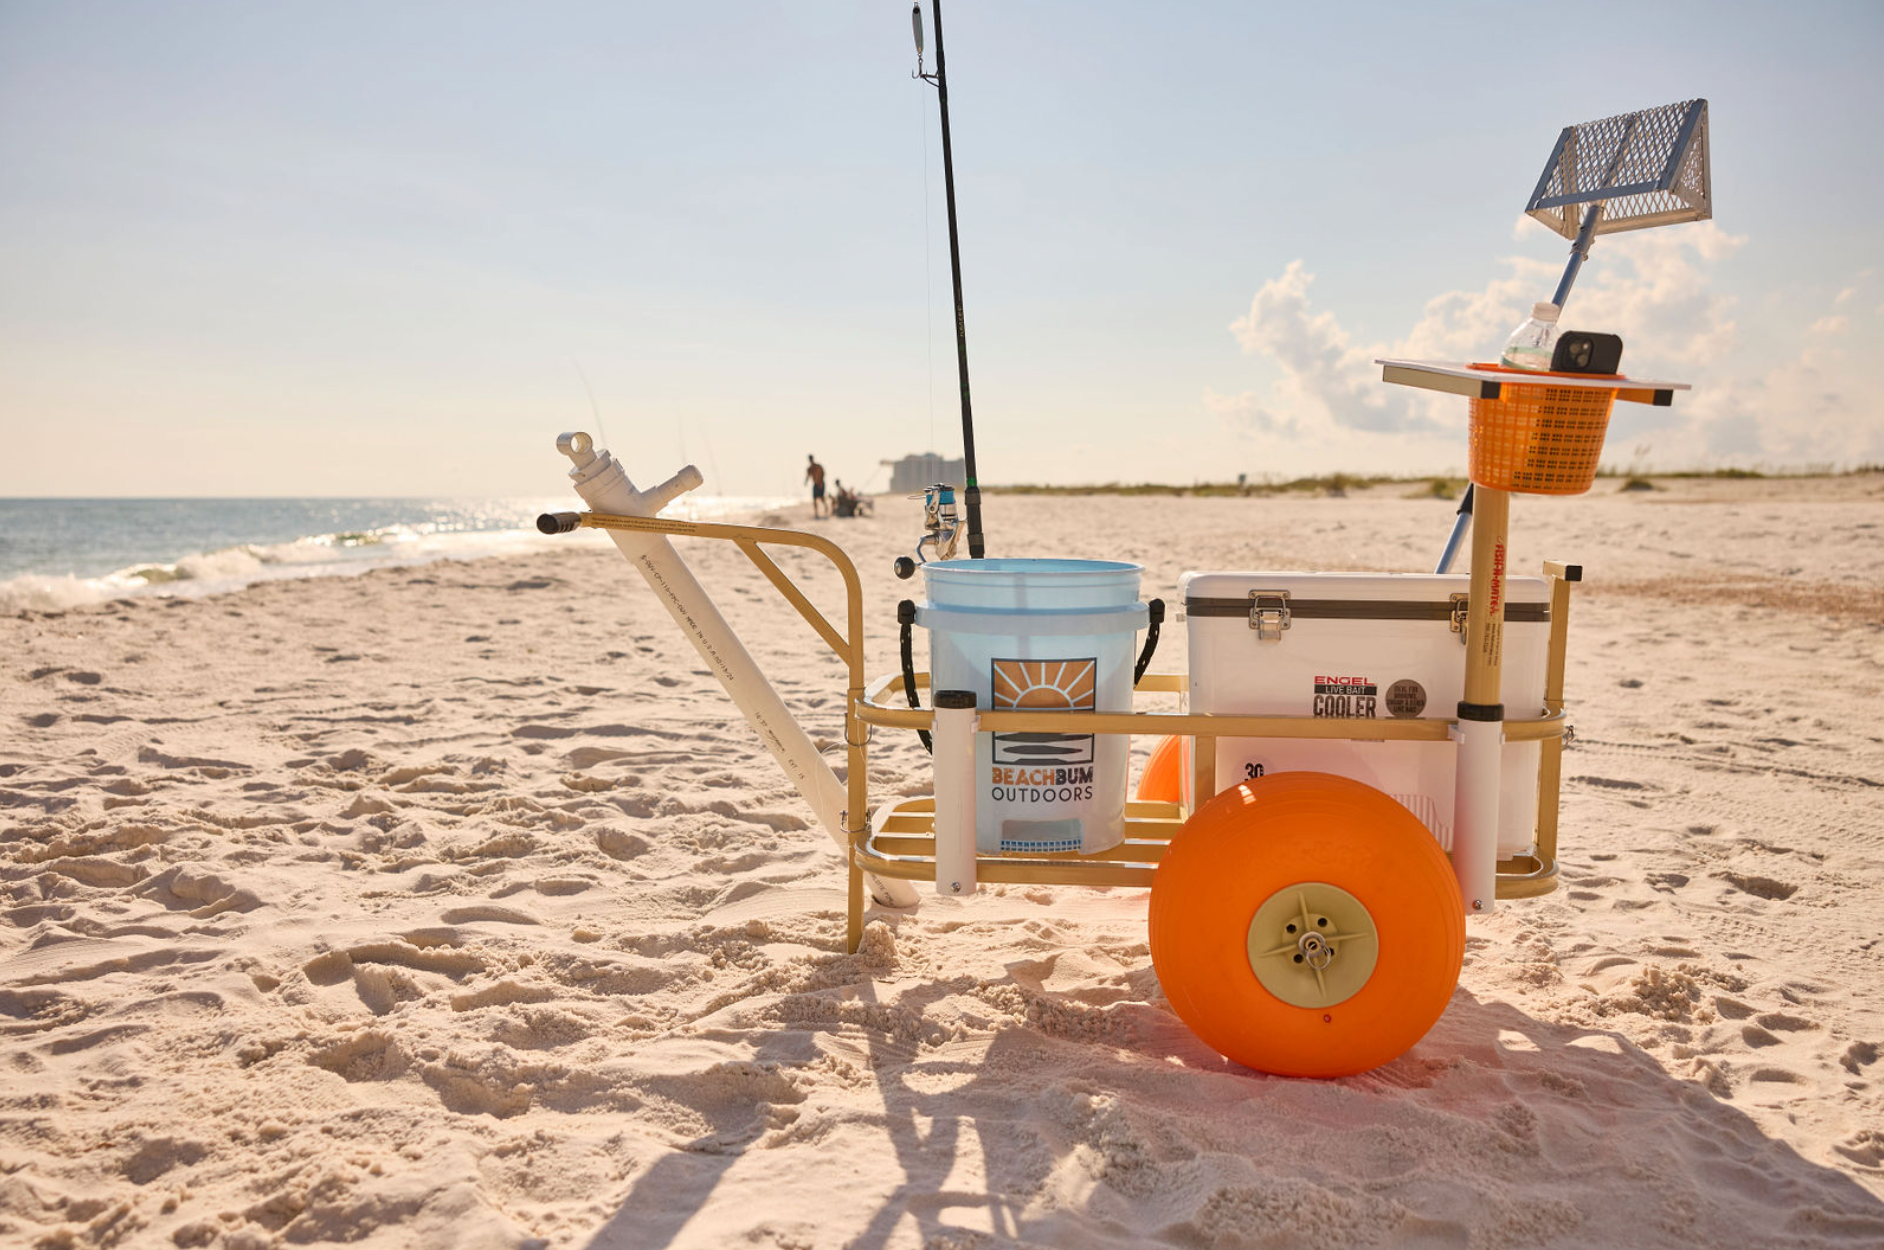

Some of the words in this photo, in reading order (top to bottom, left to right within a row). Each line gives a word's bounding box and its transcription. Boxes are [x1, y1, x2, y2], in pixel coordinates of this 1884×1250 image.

[1314, 676, 1375, 686] ENGEL
[1325, 686, 1344, 694] LIVE
[1346, 687, 1366, 695] BAIT
[1313, 695, 1377, 718] COOLER
[991, 766, 1094, 786] BEACHBUM
[991, 786, 1094, 802] OUTDOORS
